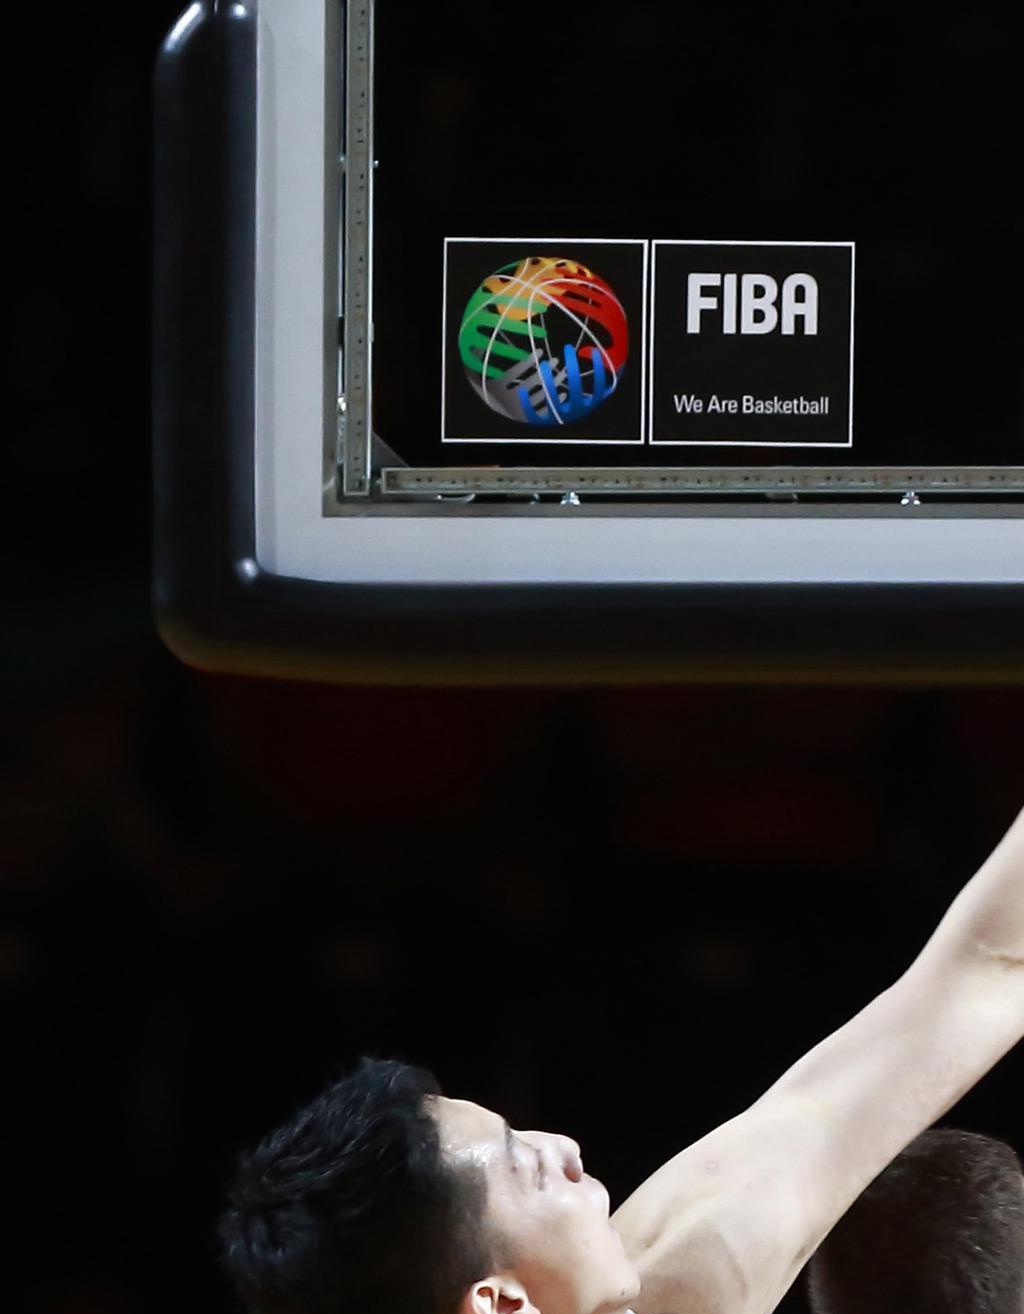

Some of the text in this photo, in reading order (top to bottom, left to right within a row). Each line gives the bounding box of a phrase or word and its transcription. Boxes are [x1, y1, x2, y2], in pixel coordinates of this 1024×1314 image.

[686, 272, 819, 336] FIBA
[673, 394, 830, 415] We Are Basketball
